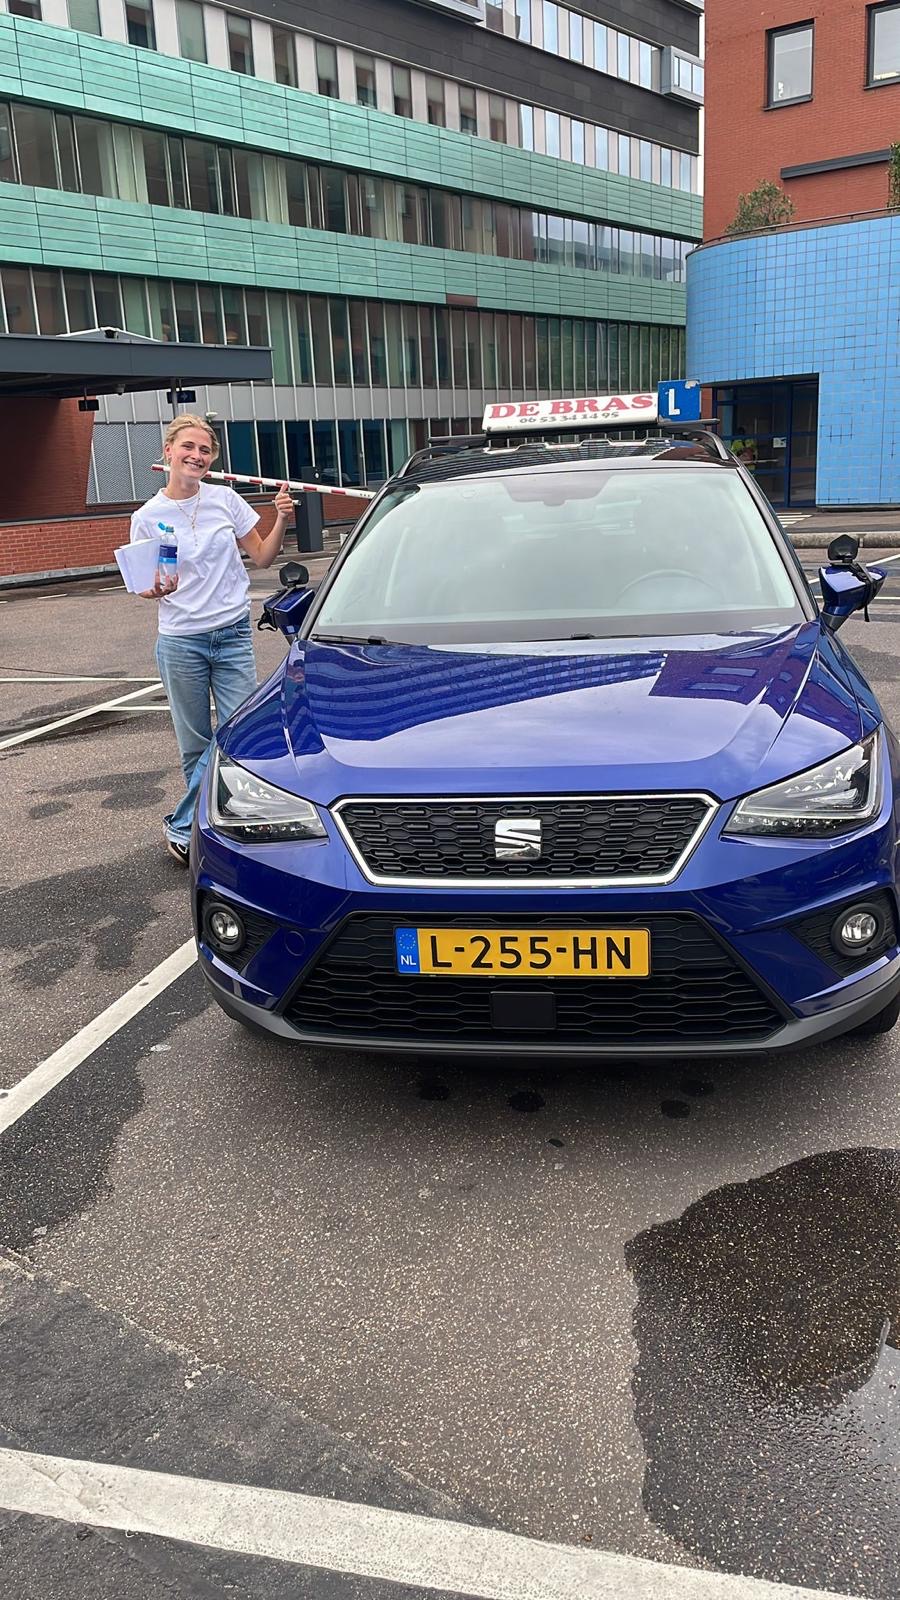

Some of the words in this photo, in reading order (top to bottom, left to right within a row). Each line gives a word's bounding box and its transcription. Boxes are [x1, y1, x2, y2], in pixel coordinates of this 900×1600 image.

[489, 402, 540, 419] DE
[549, 395, 654, 415] BRAS
[668, 388, 681, 416] L
[519, 416, 536, 424] 06
[400, 954, 417, 966] NL
[430, 935, 632, 970] L-255-HN
